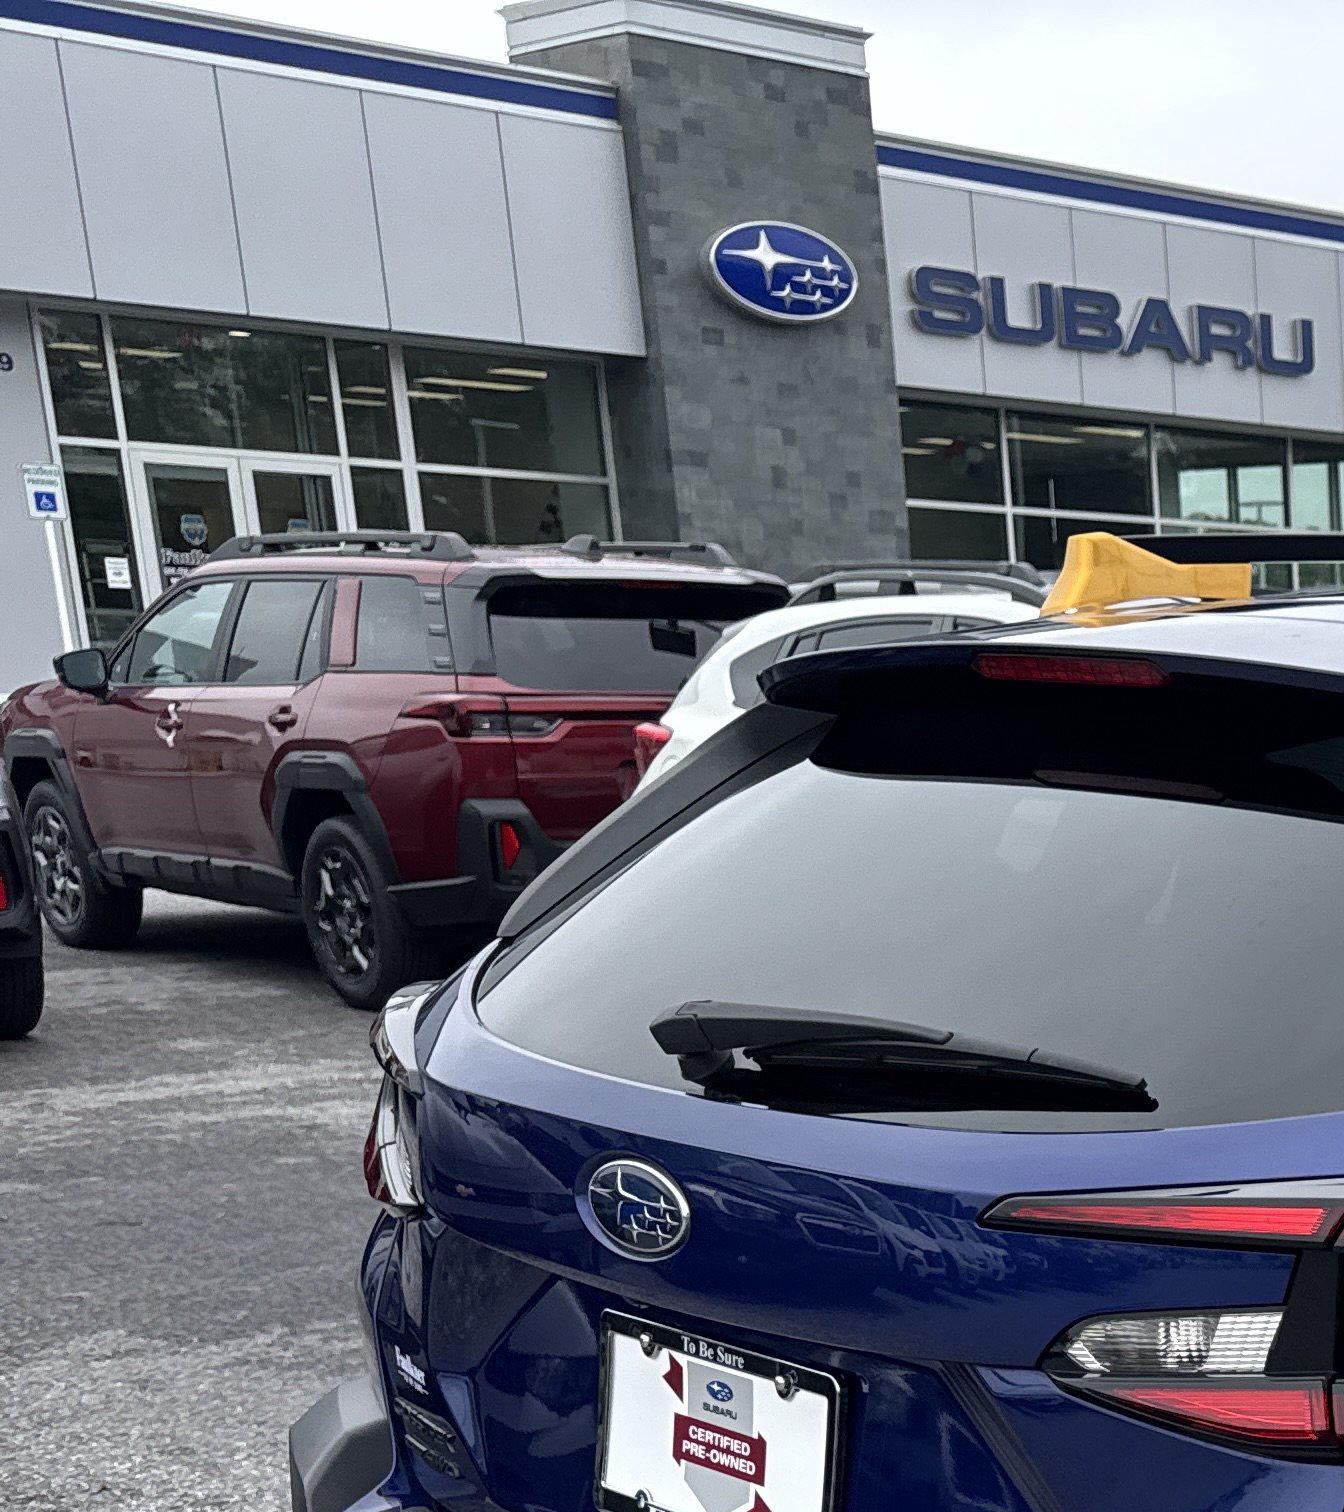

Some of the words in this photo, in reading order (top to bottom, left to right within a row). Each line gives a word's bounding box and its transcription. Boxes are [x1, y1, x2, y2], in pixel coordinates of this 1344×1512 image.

[907, 265, 1316, 377] SUBARU
[681, 1335, 696, 1354] To
[699, 1340, 714, 1359] Be
[716, 1346, 744, 1369] Sure
[702, 1402, 738, 1421] SUBARU
[688, 1425, 751, 1456] CERTIFIED
[682, 1440, 756, 1476] PRE-OWNED
